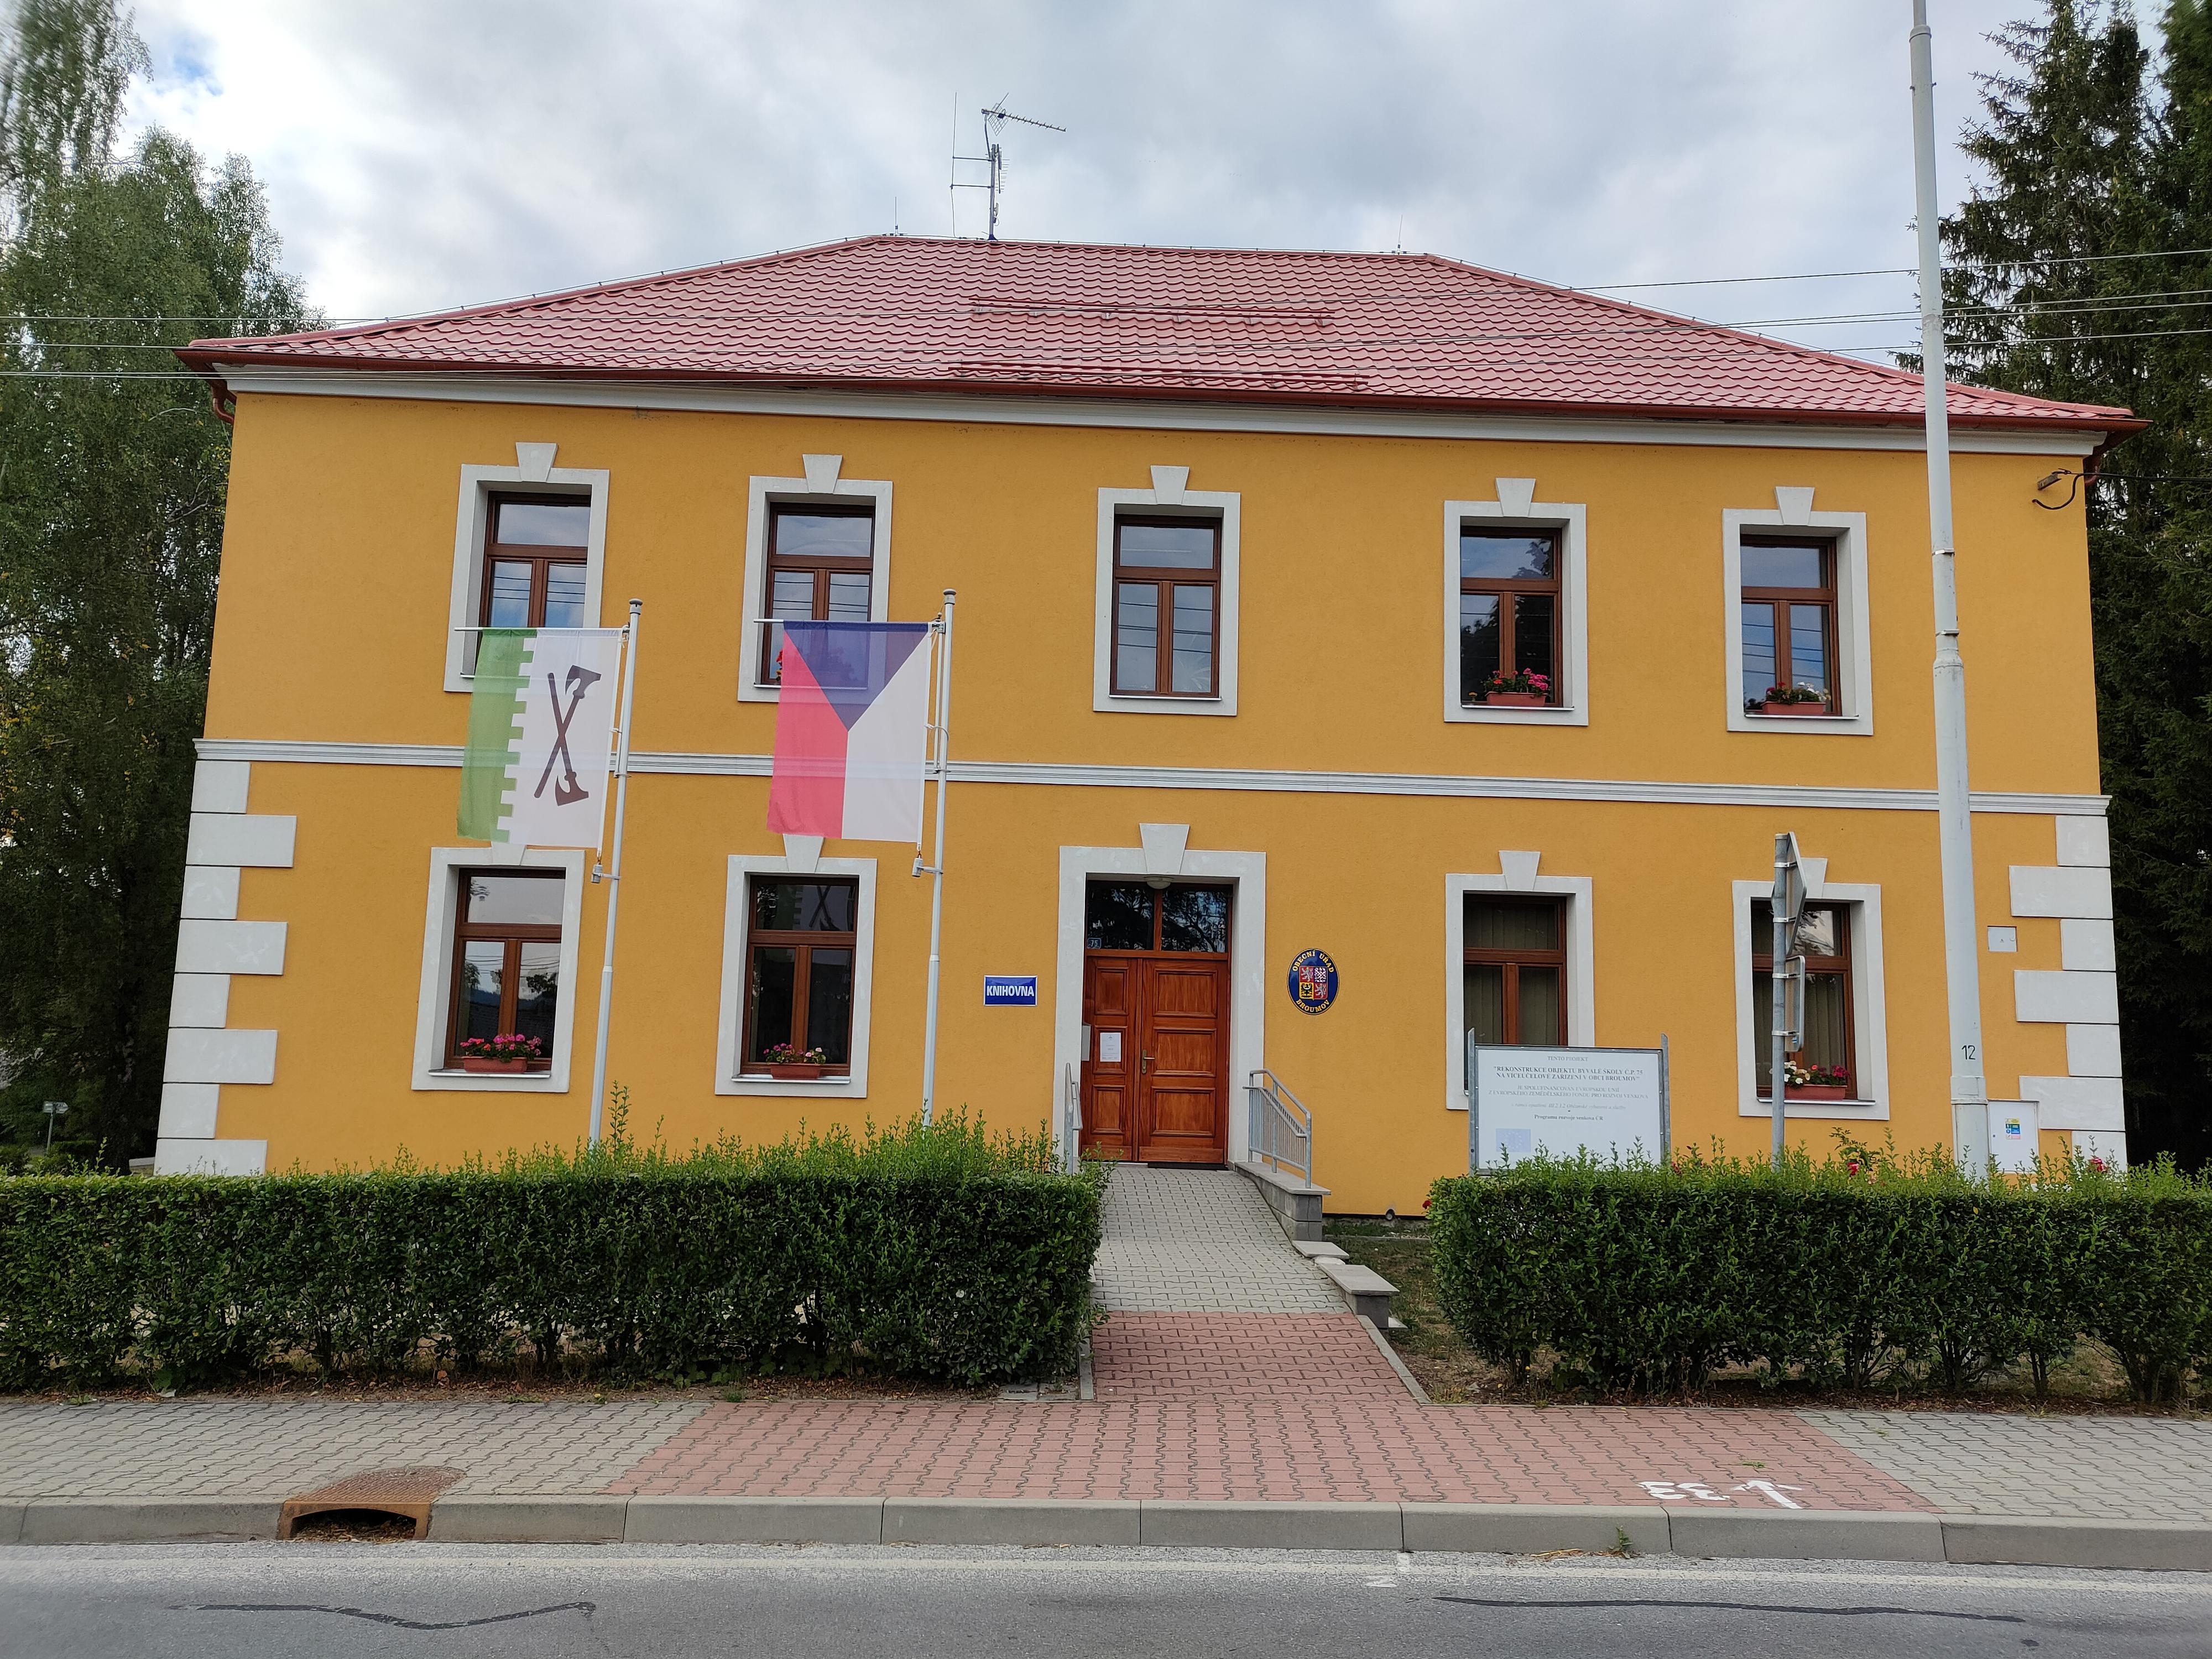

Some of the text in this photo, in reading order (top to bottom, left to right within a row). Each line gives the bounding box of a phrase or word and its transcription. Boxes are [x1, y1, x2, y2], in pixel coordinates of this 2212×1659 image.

[1292, 950, 1334, 973] OBECNÍ ÚŘAD
[987, 985, 1035, 997] KNIHOVNA
[1296, 999, 1329, 1013] BROUMOV
[1961, 1045, 1976, 1060] 12
